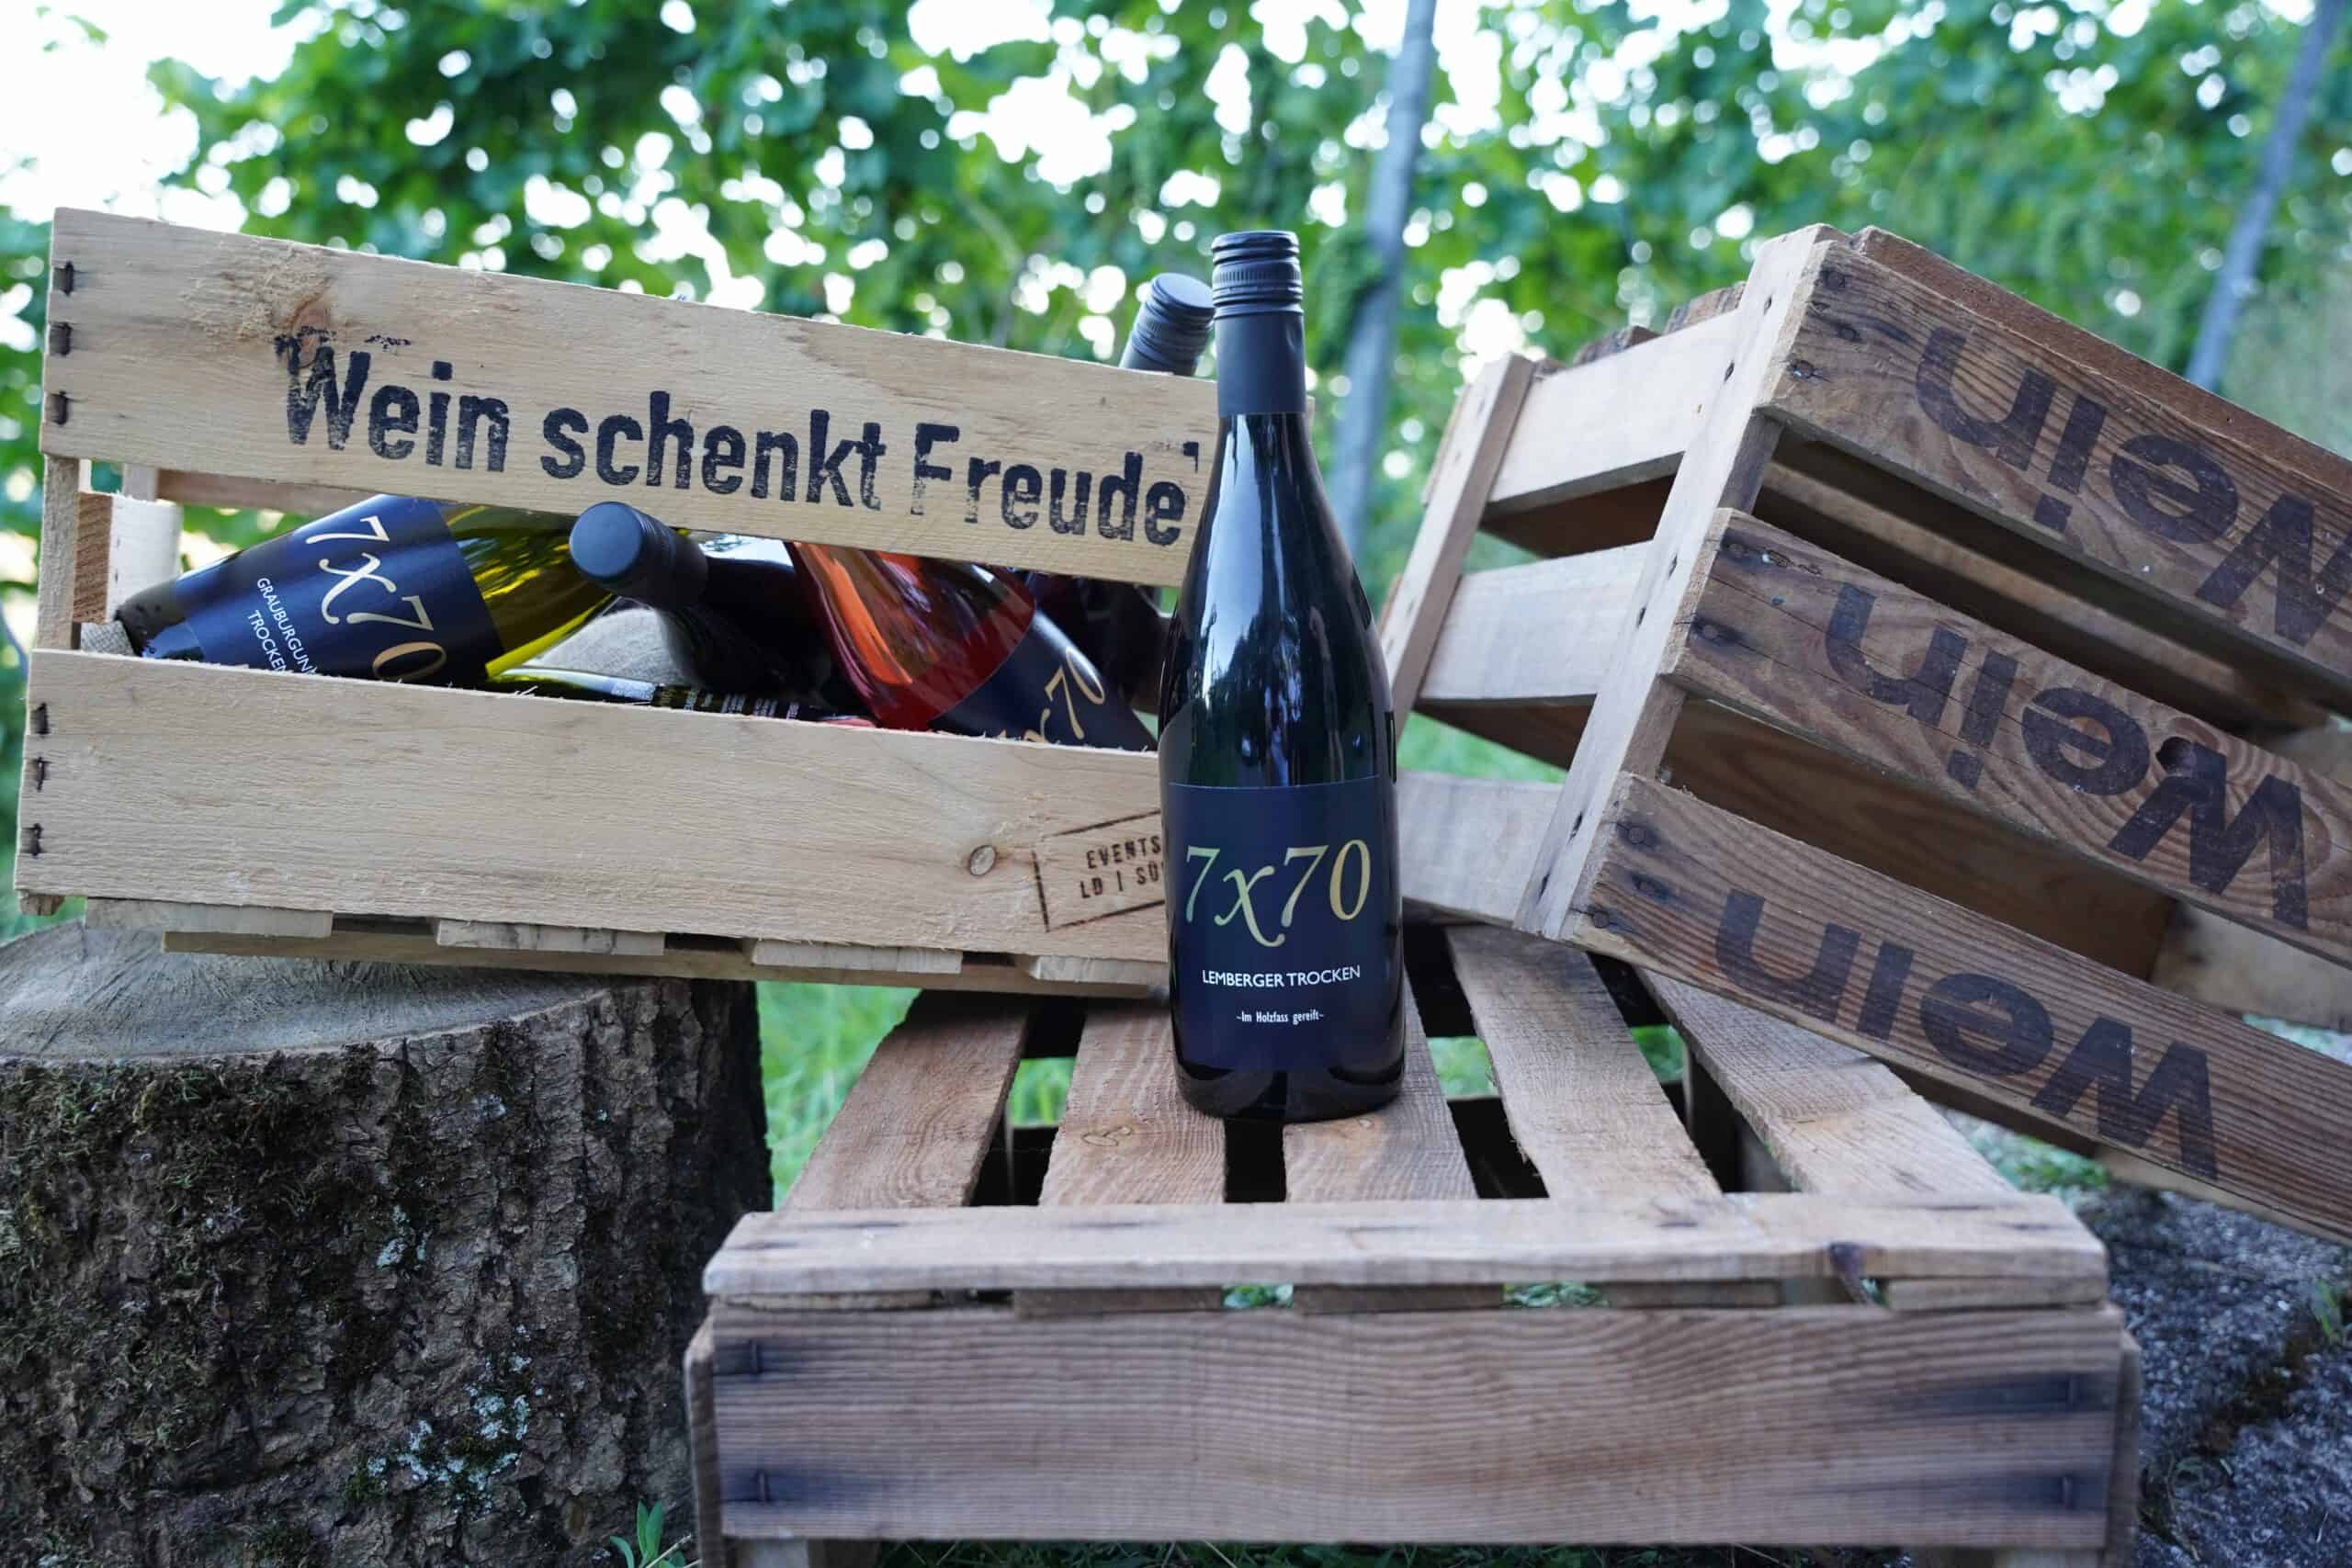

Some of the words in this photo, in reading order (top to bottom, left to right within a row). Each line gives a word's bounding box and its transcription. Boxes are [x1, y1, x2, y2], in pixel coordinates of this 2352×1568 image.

[285, 334, 510, 472] Wein
[540, 390, 887, 512] schenkt
[910, 423, 1187, 547] Freude
[1917, 327, 2352, 648] Wein
[257, 577, 317, 675] GRAUBURGUN
[1825, 582, 2309, 931] Wein
[1086, 835, 1161, 869] EVENTS
[1185, 839, 1371, 947] 7x70
[1202, 969, 1285, 987] LEMBERGER
[1286, 964, 1361, 987] TROCKEN
[1256, 1010, 1288, 1023] Holzfass
[1715, 887, 2219, 1182] Wein
